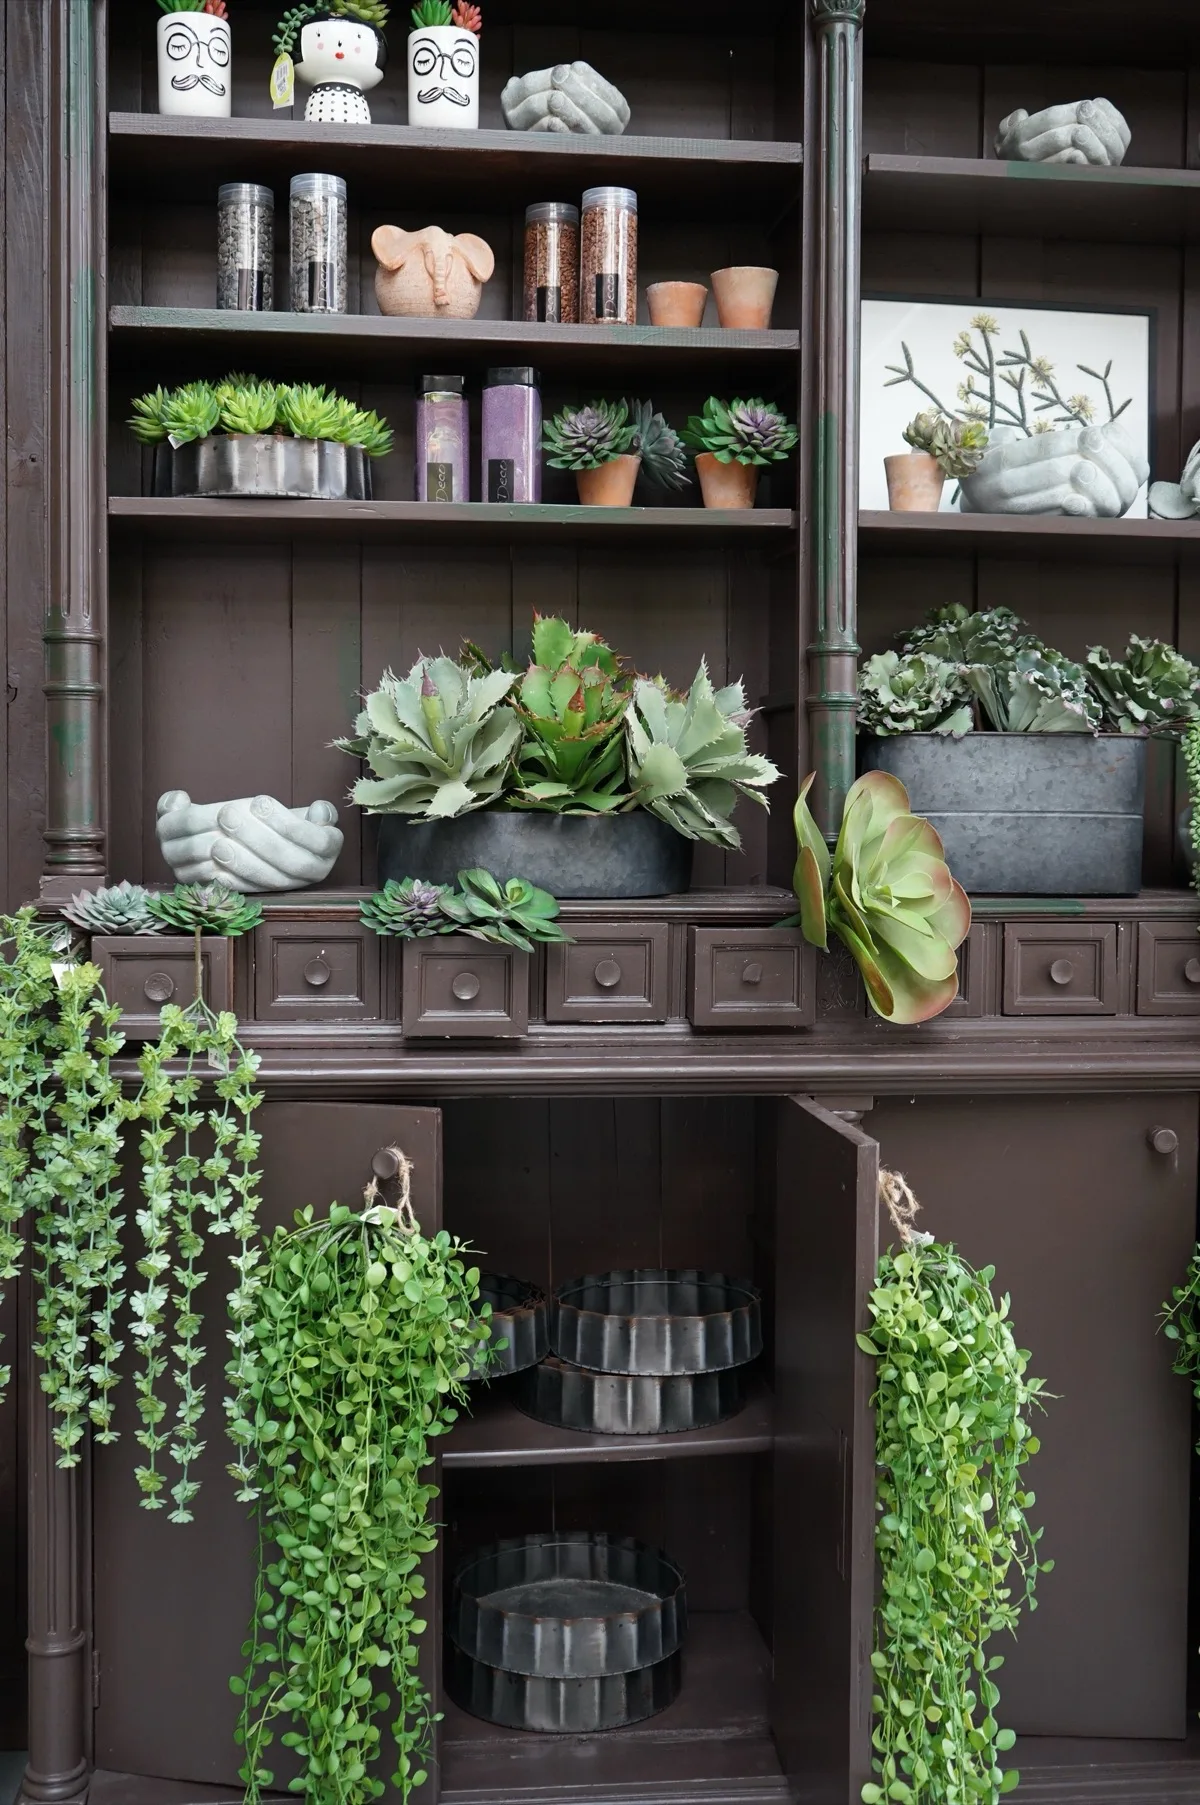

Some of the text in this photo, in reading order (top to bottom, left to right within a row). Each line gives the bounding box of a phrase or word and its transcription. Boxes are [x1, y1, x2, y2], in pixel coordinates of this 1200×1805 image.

[604, 274, 616, 314] Deco
[436, 463, 448, 503] Deco
[497, 460, 510, 502] Deco
